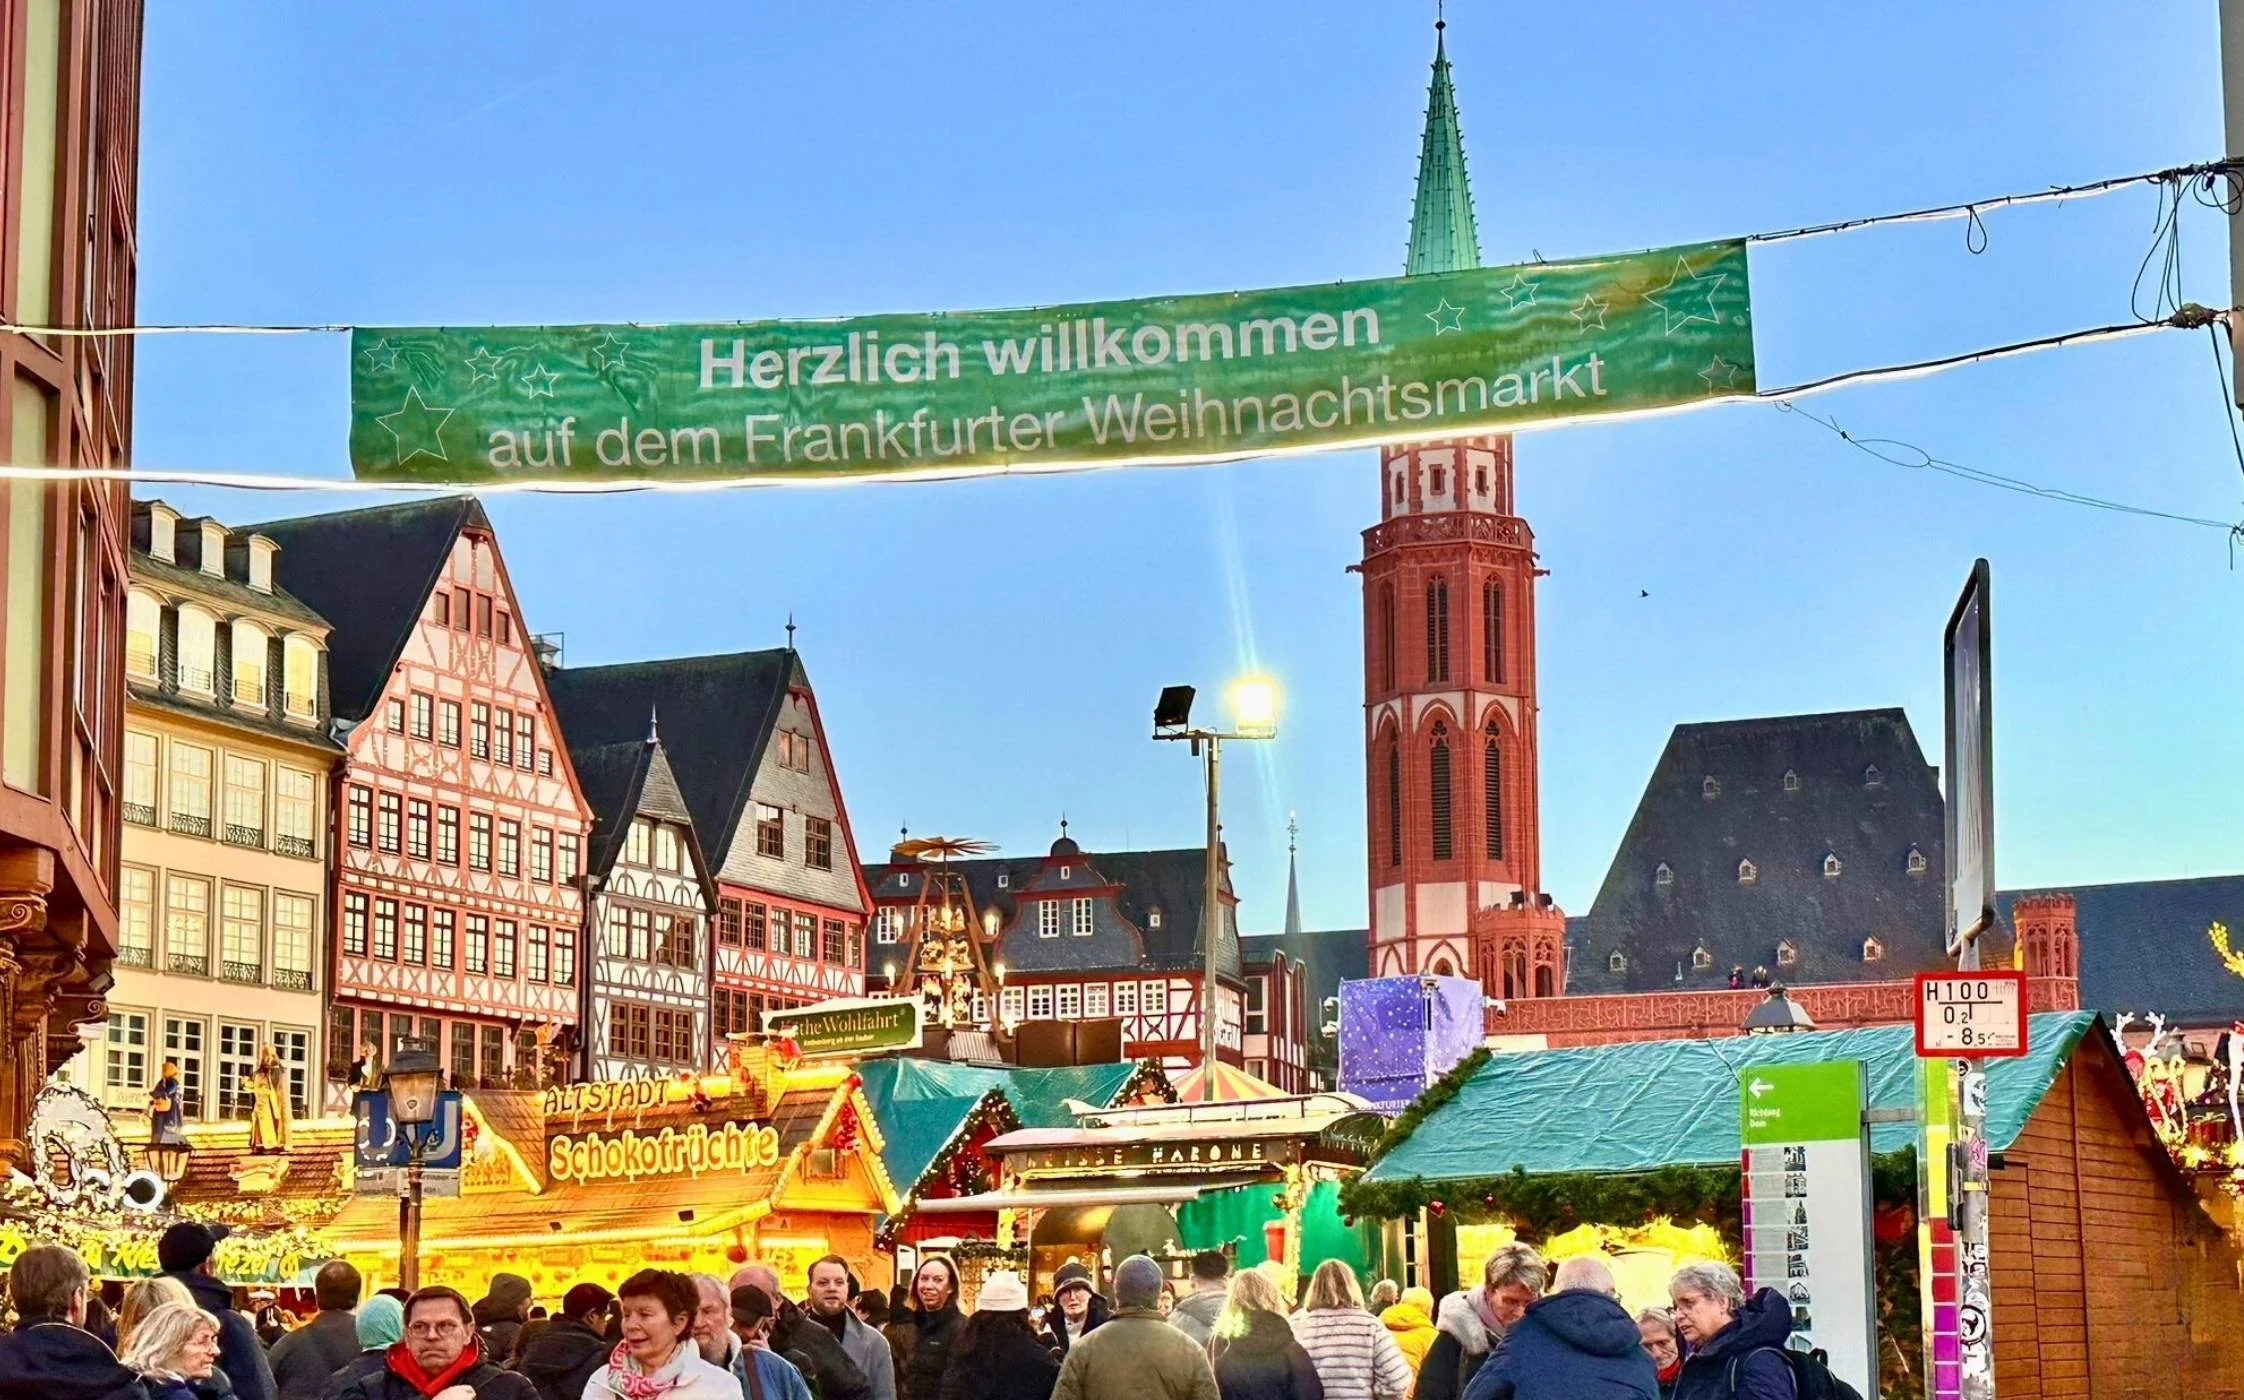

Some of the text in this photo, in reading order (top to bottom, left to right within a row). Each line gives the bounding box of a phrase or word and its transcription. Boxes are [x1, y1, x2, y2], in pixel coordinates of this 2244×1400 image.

[699, 306, 1380, 389] Herzlich willkommen
[488, 352, 1608, 469] auf dem Frankfurter Weihnachtsmarkt
[822, 1011, 899, 1033] Wohlfahrt
[544, 1078, 669, 1116] ALTSTADT
[551, 1122, 778, 1180] Schokofrüchte
